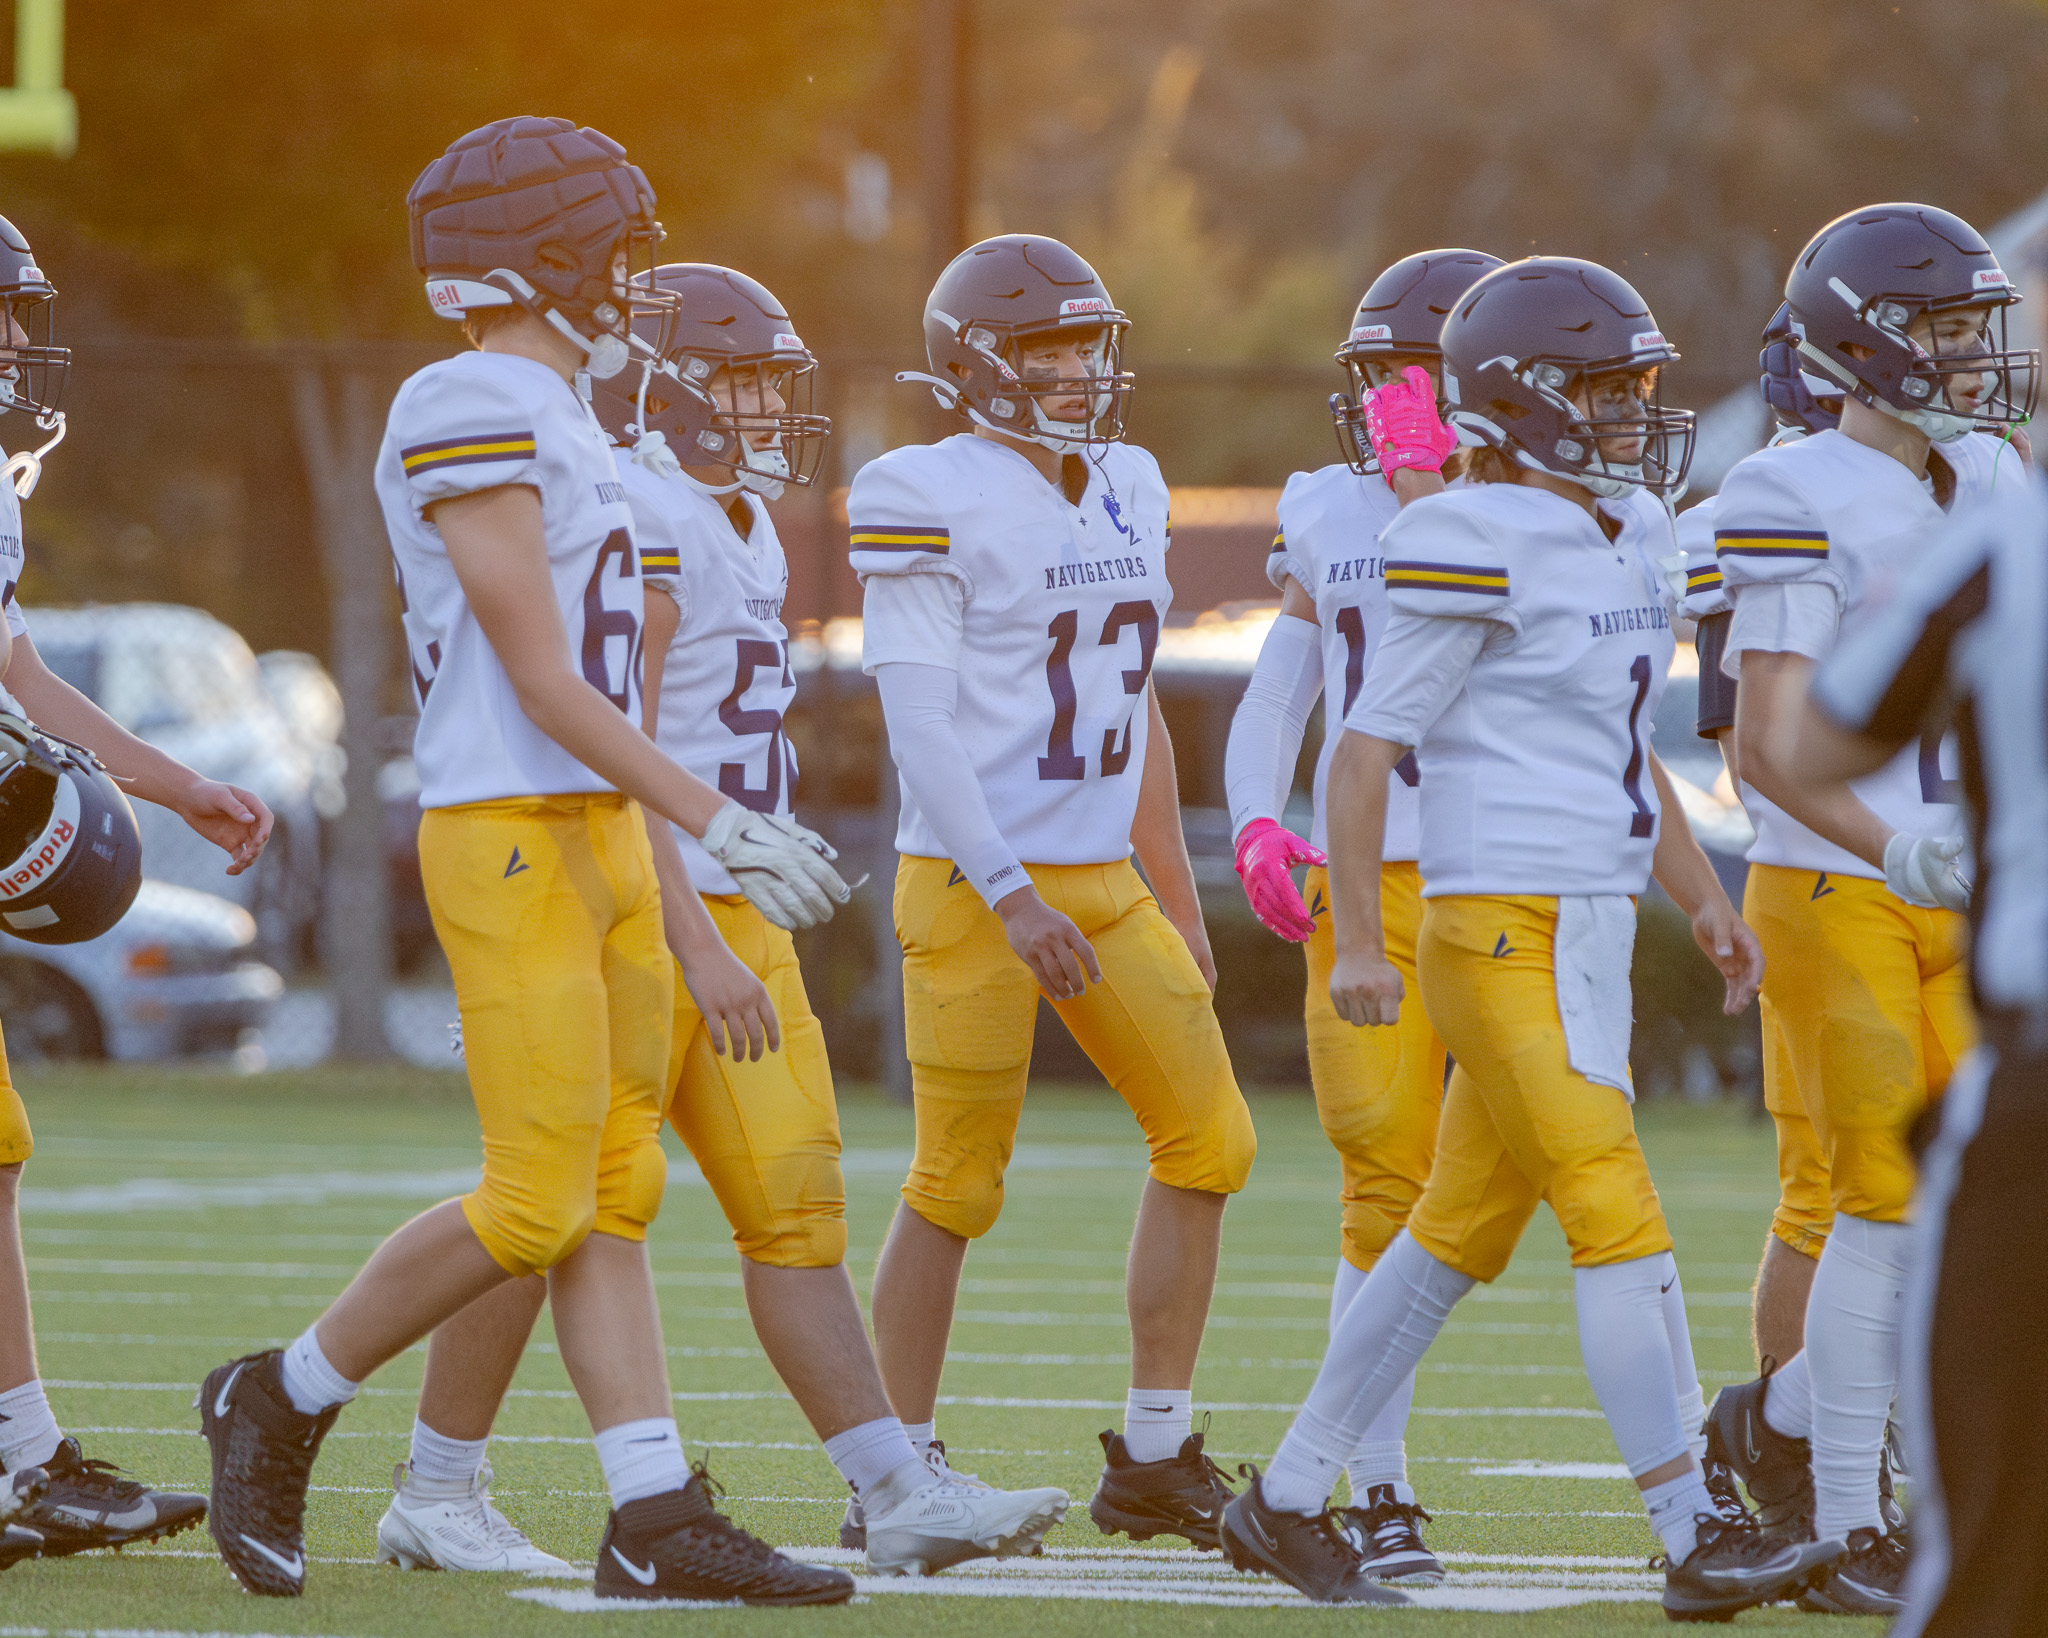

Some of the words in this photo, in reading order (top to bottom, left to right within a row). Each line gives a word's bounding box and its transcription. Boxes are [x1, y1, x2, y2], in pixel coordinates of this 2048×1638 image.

[1067, 300, 1105, 312] Riddell
[1045, 556, 1148, 590] NAVIGATORS
[1589, 606, 1670, 637] NAVIGATORS
[1037, 599, 1160, 781] 13
[1623, 654, 1657, 839] 1
[986, 865, 1014, 887] NXTRND
